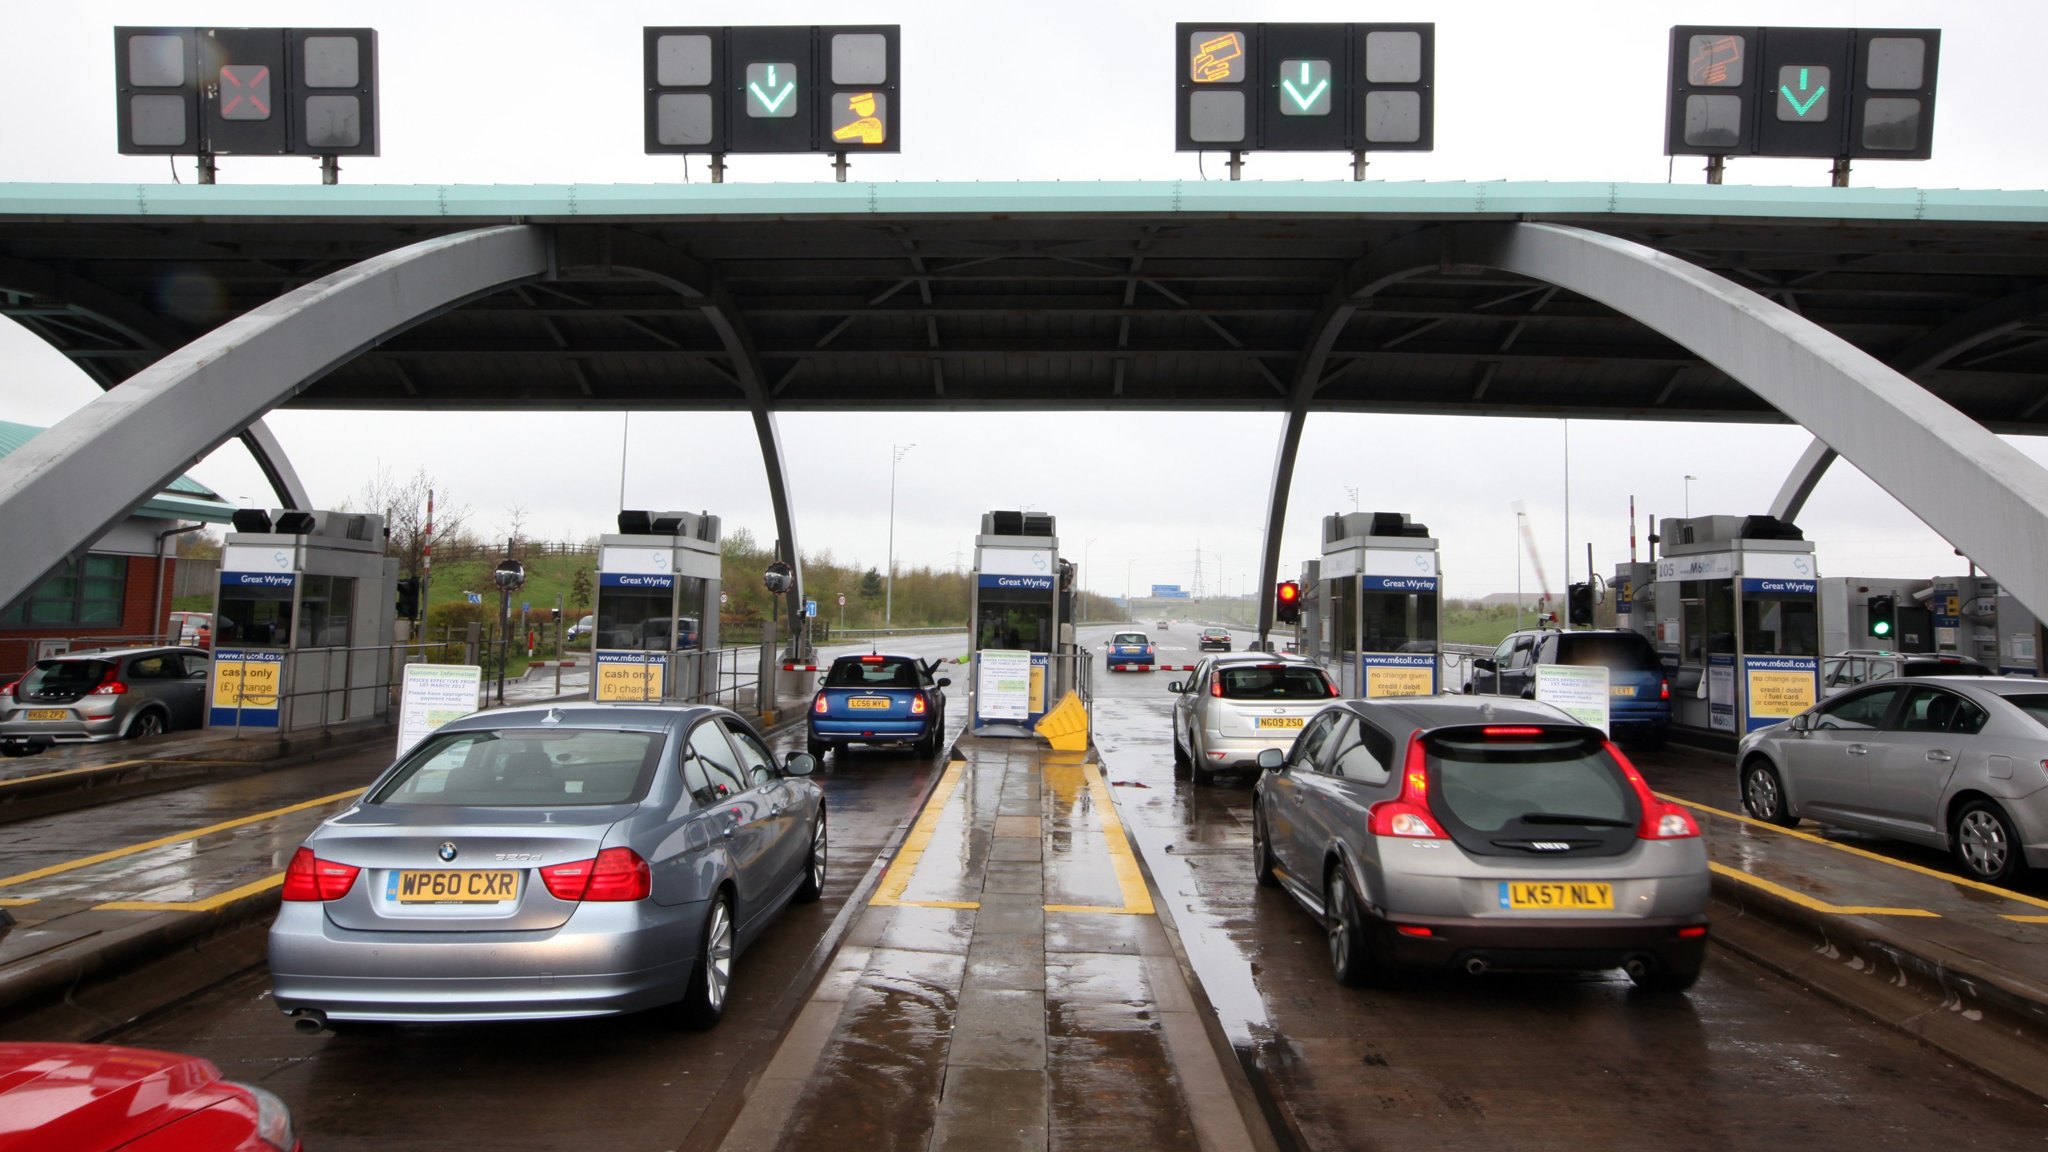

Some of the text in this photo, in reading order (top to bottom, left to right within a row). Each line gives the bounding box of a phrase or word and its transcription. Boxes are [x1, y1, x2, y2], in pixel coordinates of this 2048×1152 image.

[1659, 563, 1674, 577] 105
[241, 575, 292, 586] Great Wyrley
[620, 576, 671, 587] Great Wyrley
[1023, 578, 1050, 588] Wyrley
[1383, 579, 1435, 590] Great Wyrley
[1762, 582, 1814, 592] Great Wyrley
[1747, 660, 1816, 668] www.m6toll.co.uk
[250, 668, 272, 679] only
[604, 670, 654, 681] cash ony
[604, 683, 617, 694] (£)
[402, 874, 514, 895] WP60 CXR
[1512, 885, 1609, 905] LK57 NLY
